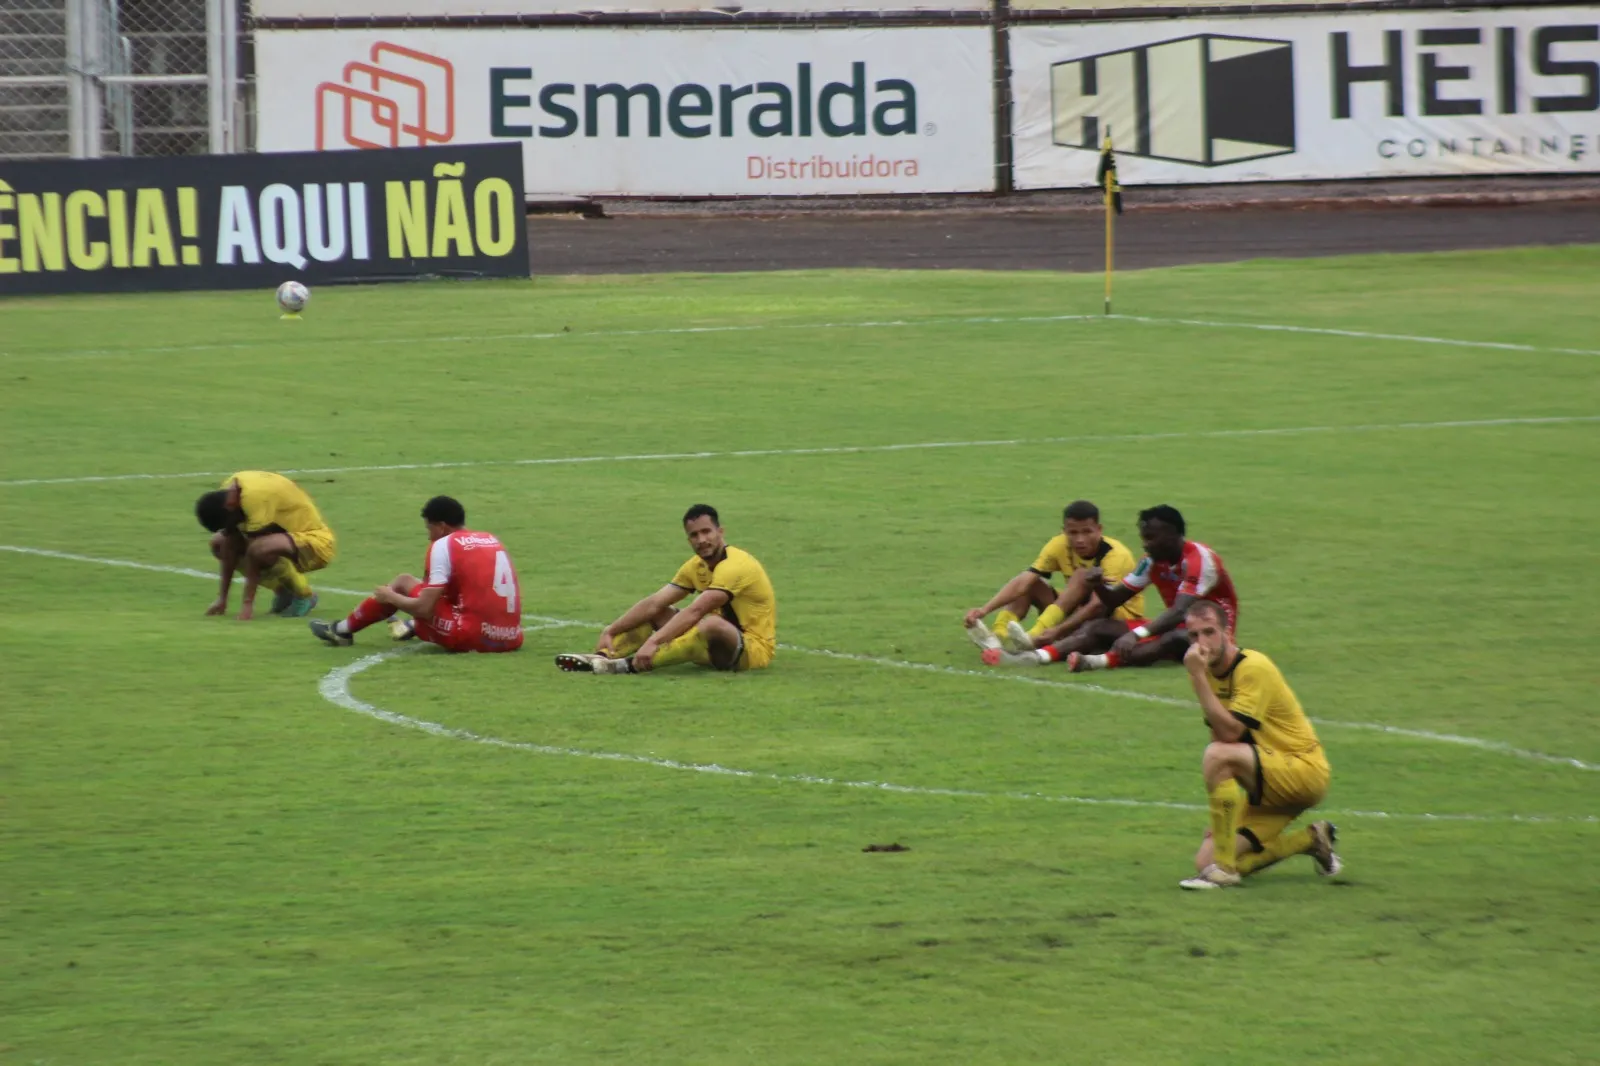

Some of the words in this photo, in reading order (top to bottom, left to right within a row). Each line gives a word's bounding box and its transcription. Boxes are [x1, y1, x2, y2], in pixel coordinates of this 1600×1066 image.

[489, 61, 917, 139] Esmeralda
[1328, 24, 1600, 119] HEIS
[747, 154, 919, 180] Distribuidora
[1377, 133, 1600, 161] CONTAINE
[216, 182, 370, 271] AQUI
[385, 162, 516, 259] NÃO
[493, 550, 516, 613] 4
